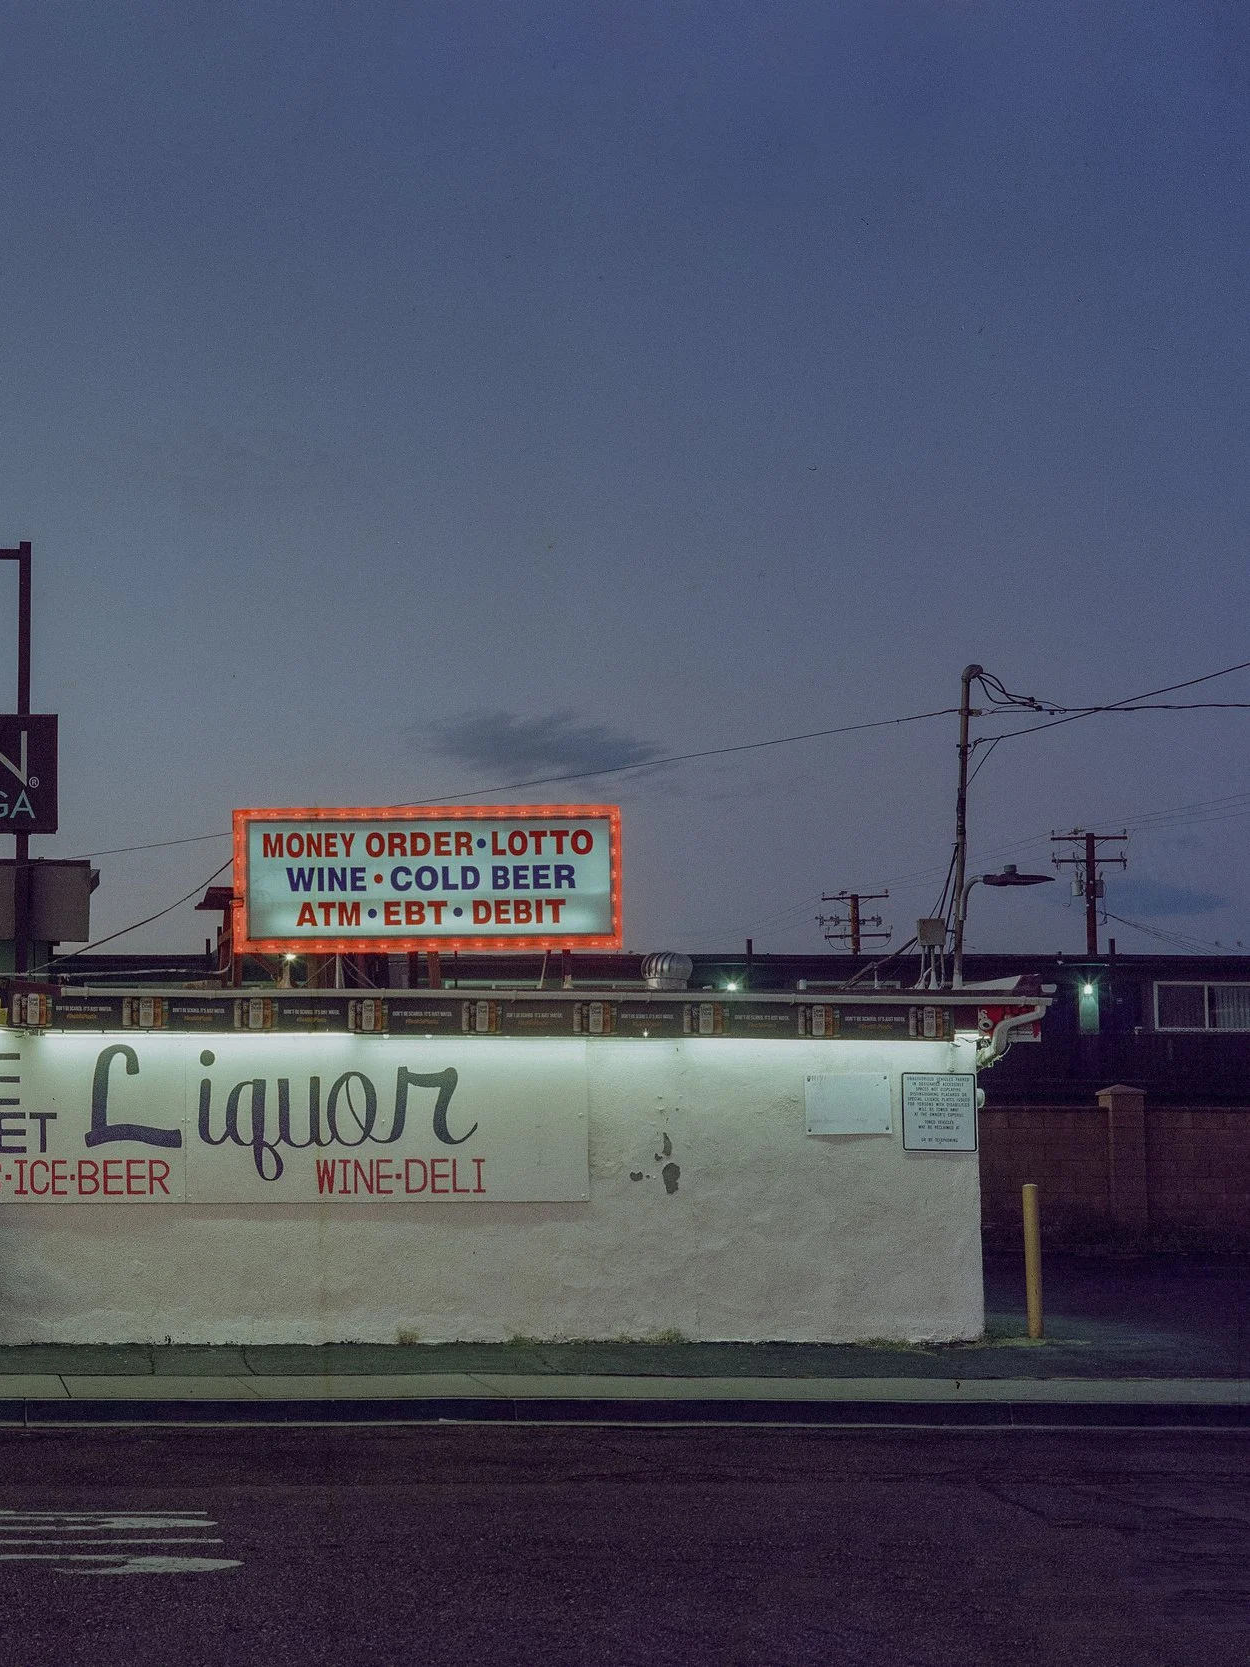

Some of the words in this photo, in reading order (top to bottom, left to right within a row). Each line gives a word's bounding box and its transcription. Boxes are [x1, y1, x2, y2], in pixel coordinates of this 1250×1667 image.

[262, 832, 356, 859] MONEY
[365, 831, 473, 858] ORDER
[491, 829, 594, 856] LOTTO
[285, 866, 367, 893] WINE
[390, 865, 481, 891] COLD
[491, 864, 576, 890] BEER
[296, 901, 361, 927] ATM
[383, 900, 448, 926] EBT
[472, 899, 566, 925] DEBIT
[84, 1043, 478, 1181] Liquor
[15, 1159, 68, 1195] ICE
[78, 1159, 171, 1196] BEER
[316, 1158, 394, 1195] WINE
[405, 1158, 486, 1194] DELI
